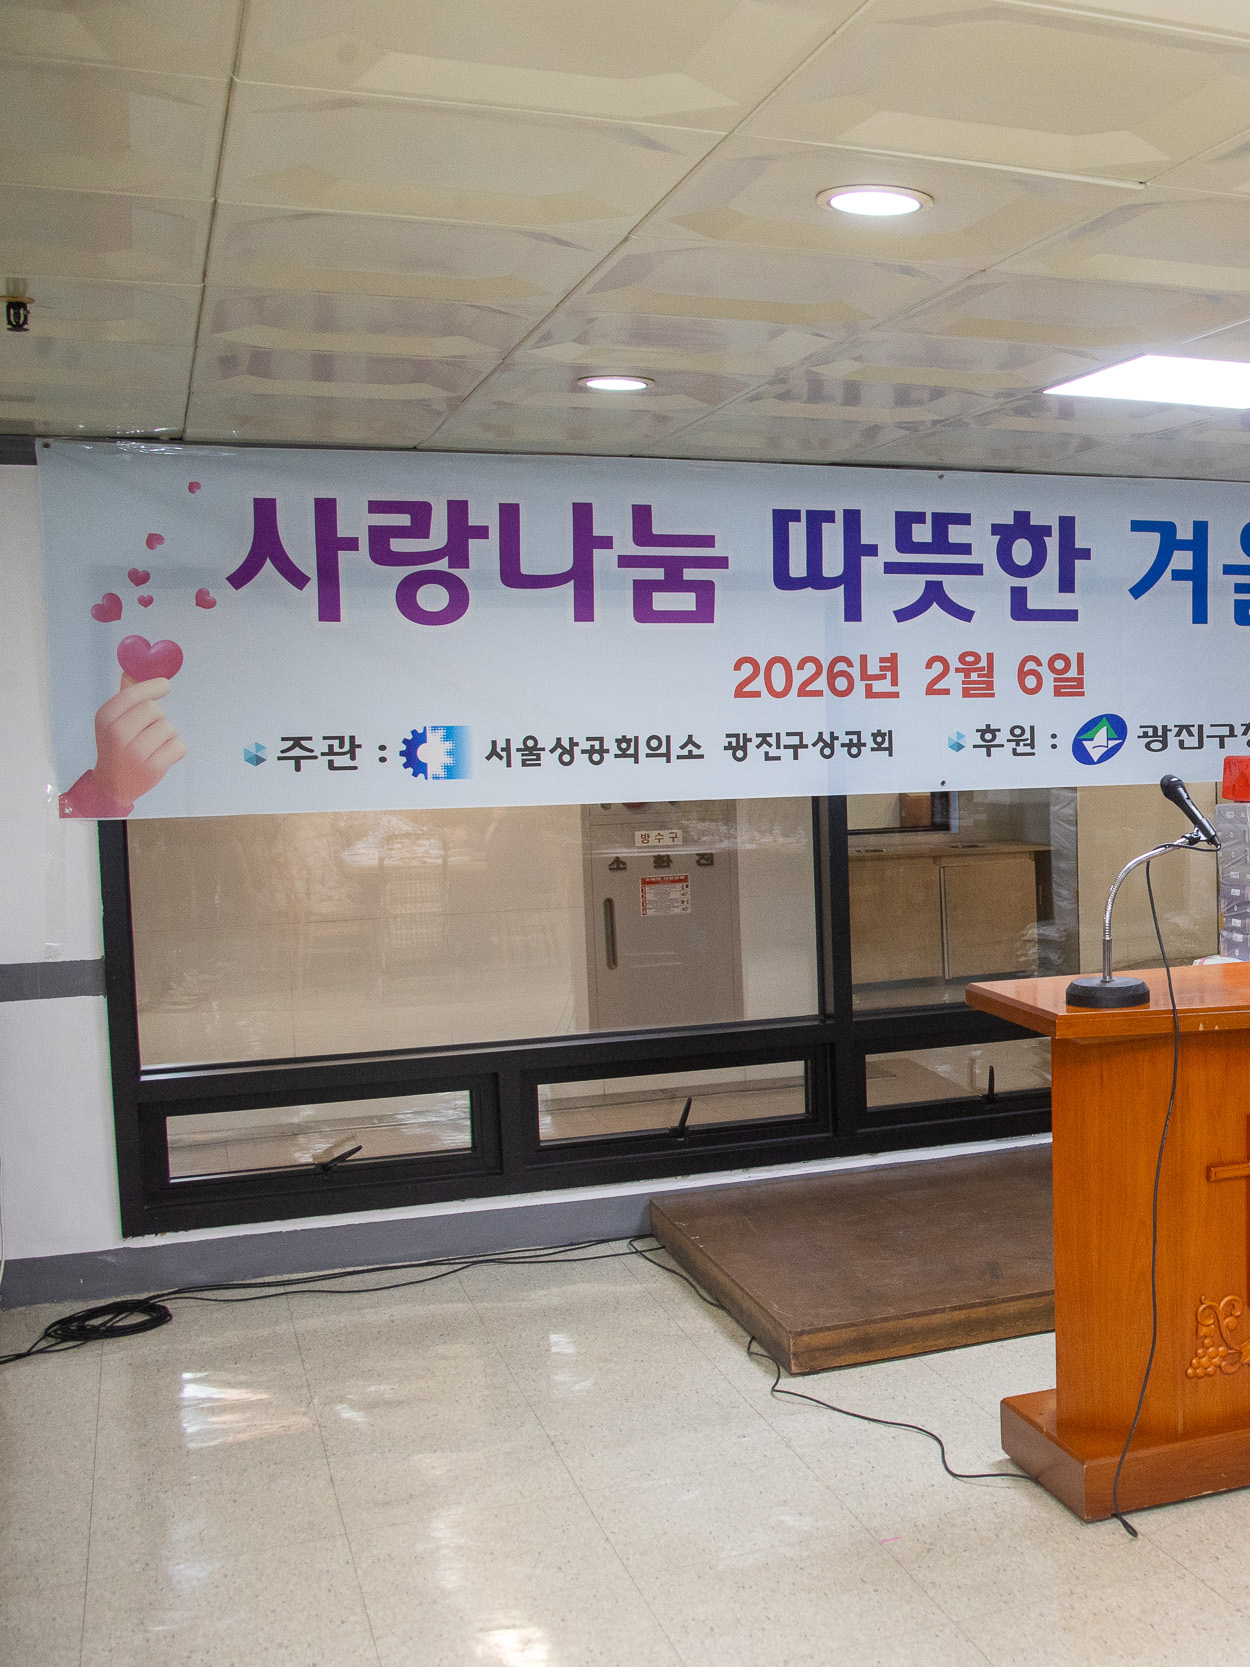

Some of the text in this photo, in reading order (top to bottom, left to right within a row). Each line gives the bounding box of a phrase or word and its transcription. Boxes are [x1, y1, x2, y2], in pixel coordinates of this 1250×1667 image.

[226, 497, 730, 626] 사랑나눔
[772, 508, 1092, 624] 따뜻한
[733, 650, 1086, 699] 2026년 2월 6일
[276, 735, 363, 773] 주관
[484, 734, 705, 769] 서울상공회의소
[723, 729, 894, 763] 광진구상공회
[972, 723, 1037, 758] 후원
[640, 831, 679, 844] 방수구
